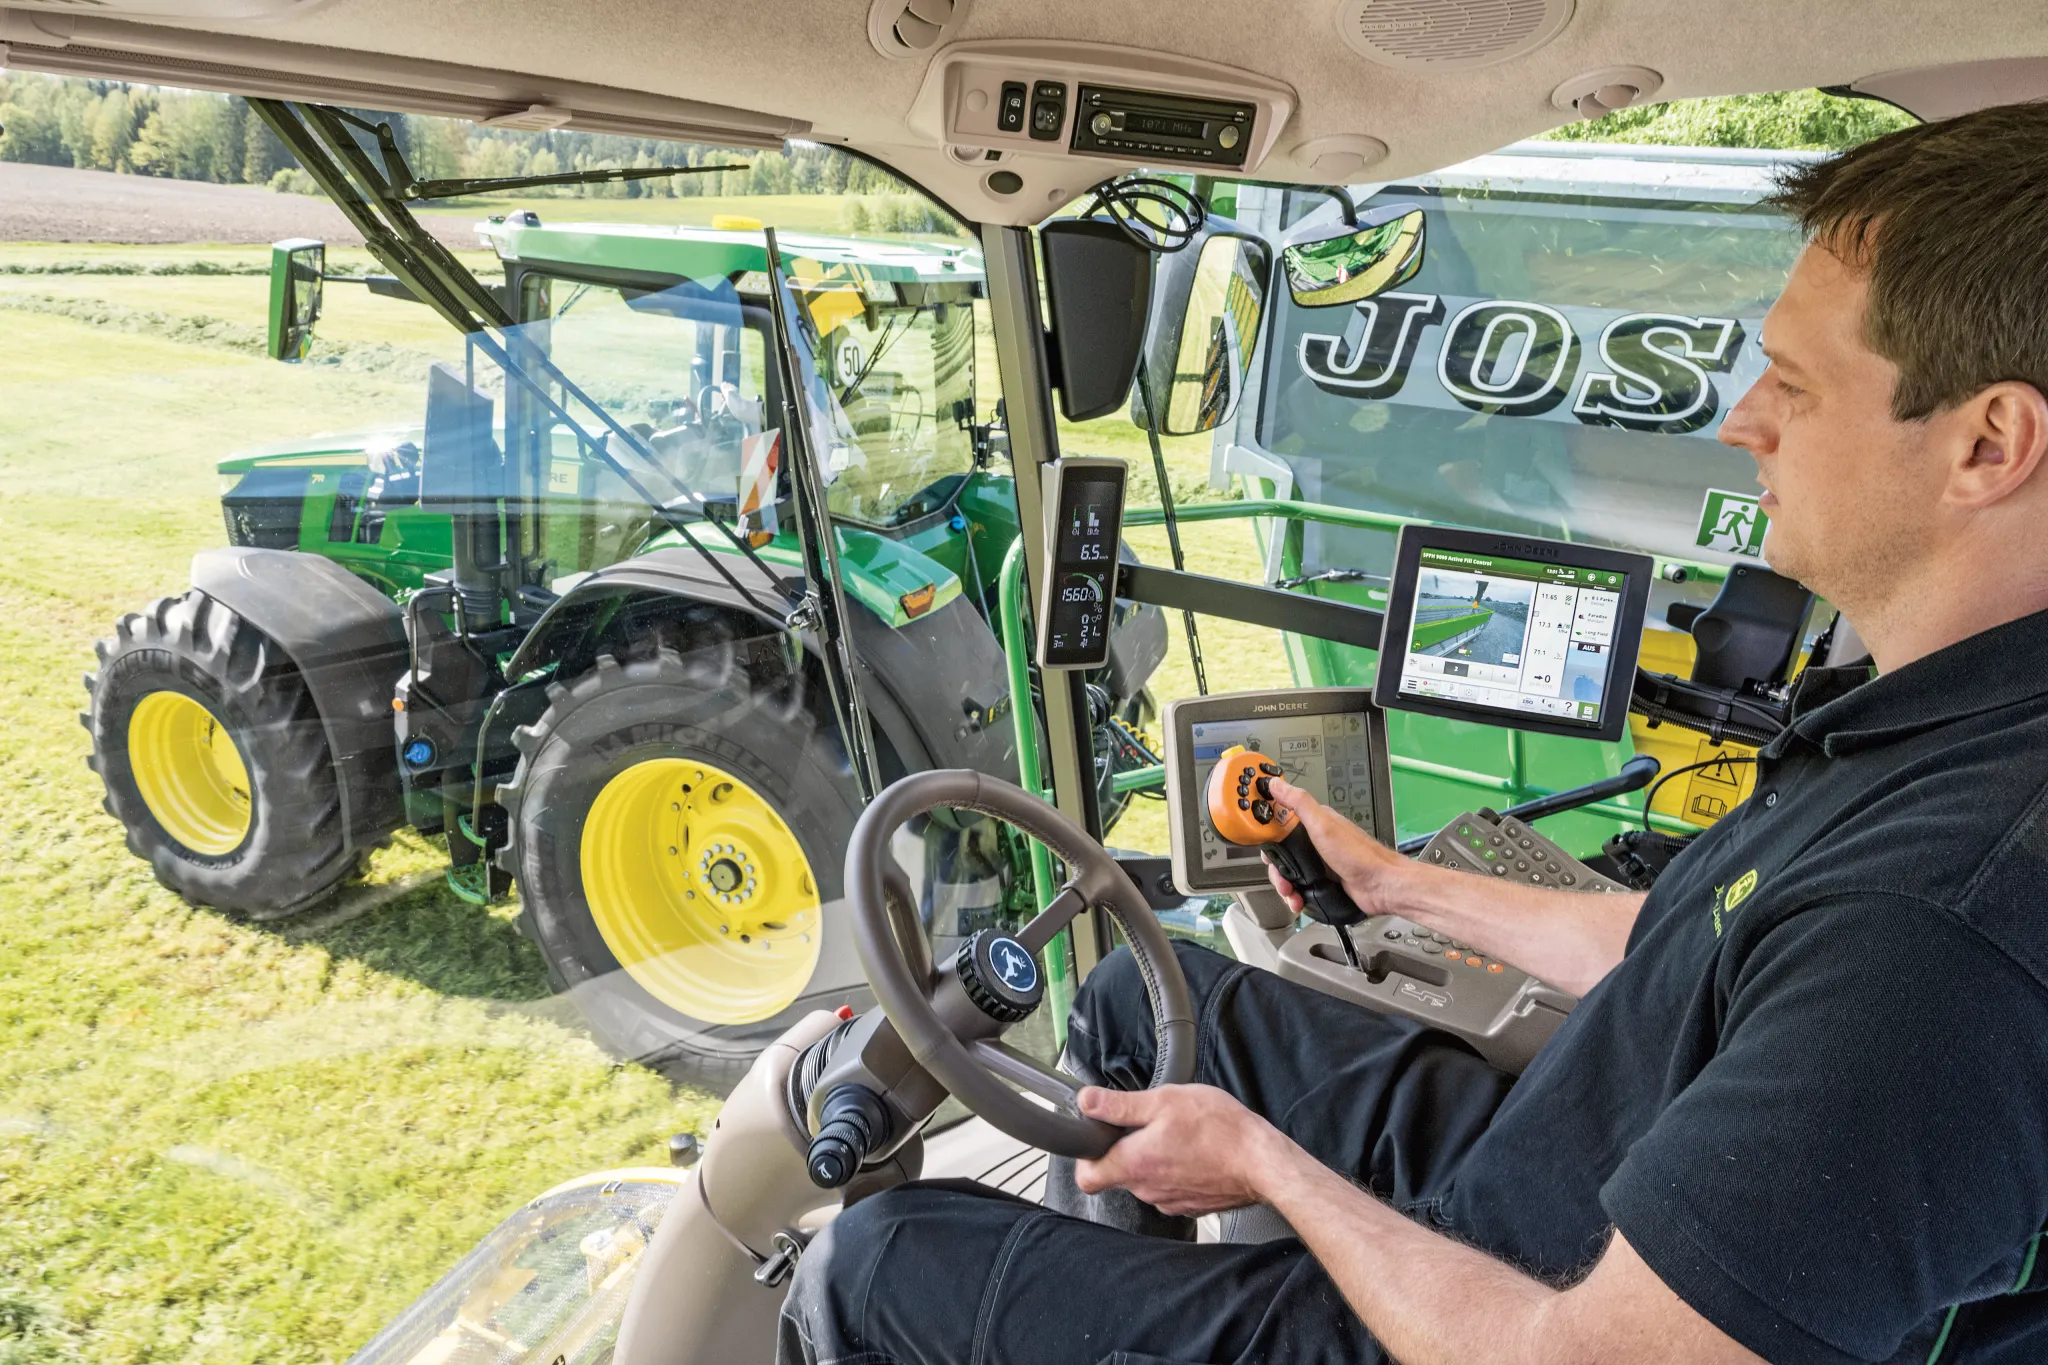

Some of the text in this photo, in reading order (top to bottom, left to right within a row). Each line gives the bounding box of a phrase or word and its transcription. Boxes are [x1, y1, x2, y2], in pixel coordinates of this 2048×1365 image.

[843, 345, 860, 377] 50
[1299, 292, 1748, 434] JOS
[550, 472, 568, 484] RE
[1080, 544, 1100, 560] 6.5
[1062, 588, 1089, 602] 1560
[1582, 644, 1596, 652] AUS
[1544, 674, 1551, 683] 0
[1253, 702, 1309, 713] JOHN DEERE
[1289, 741, 1307, 750] 2.00
